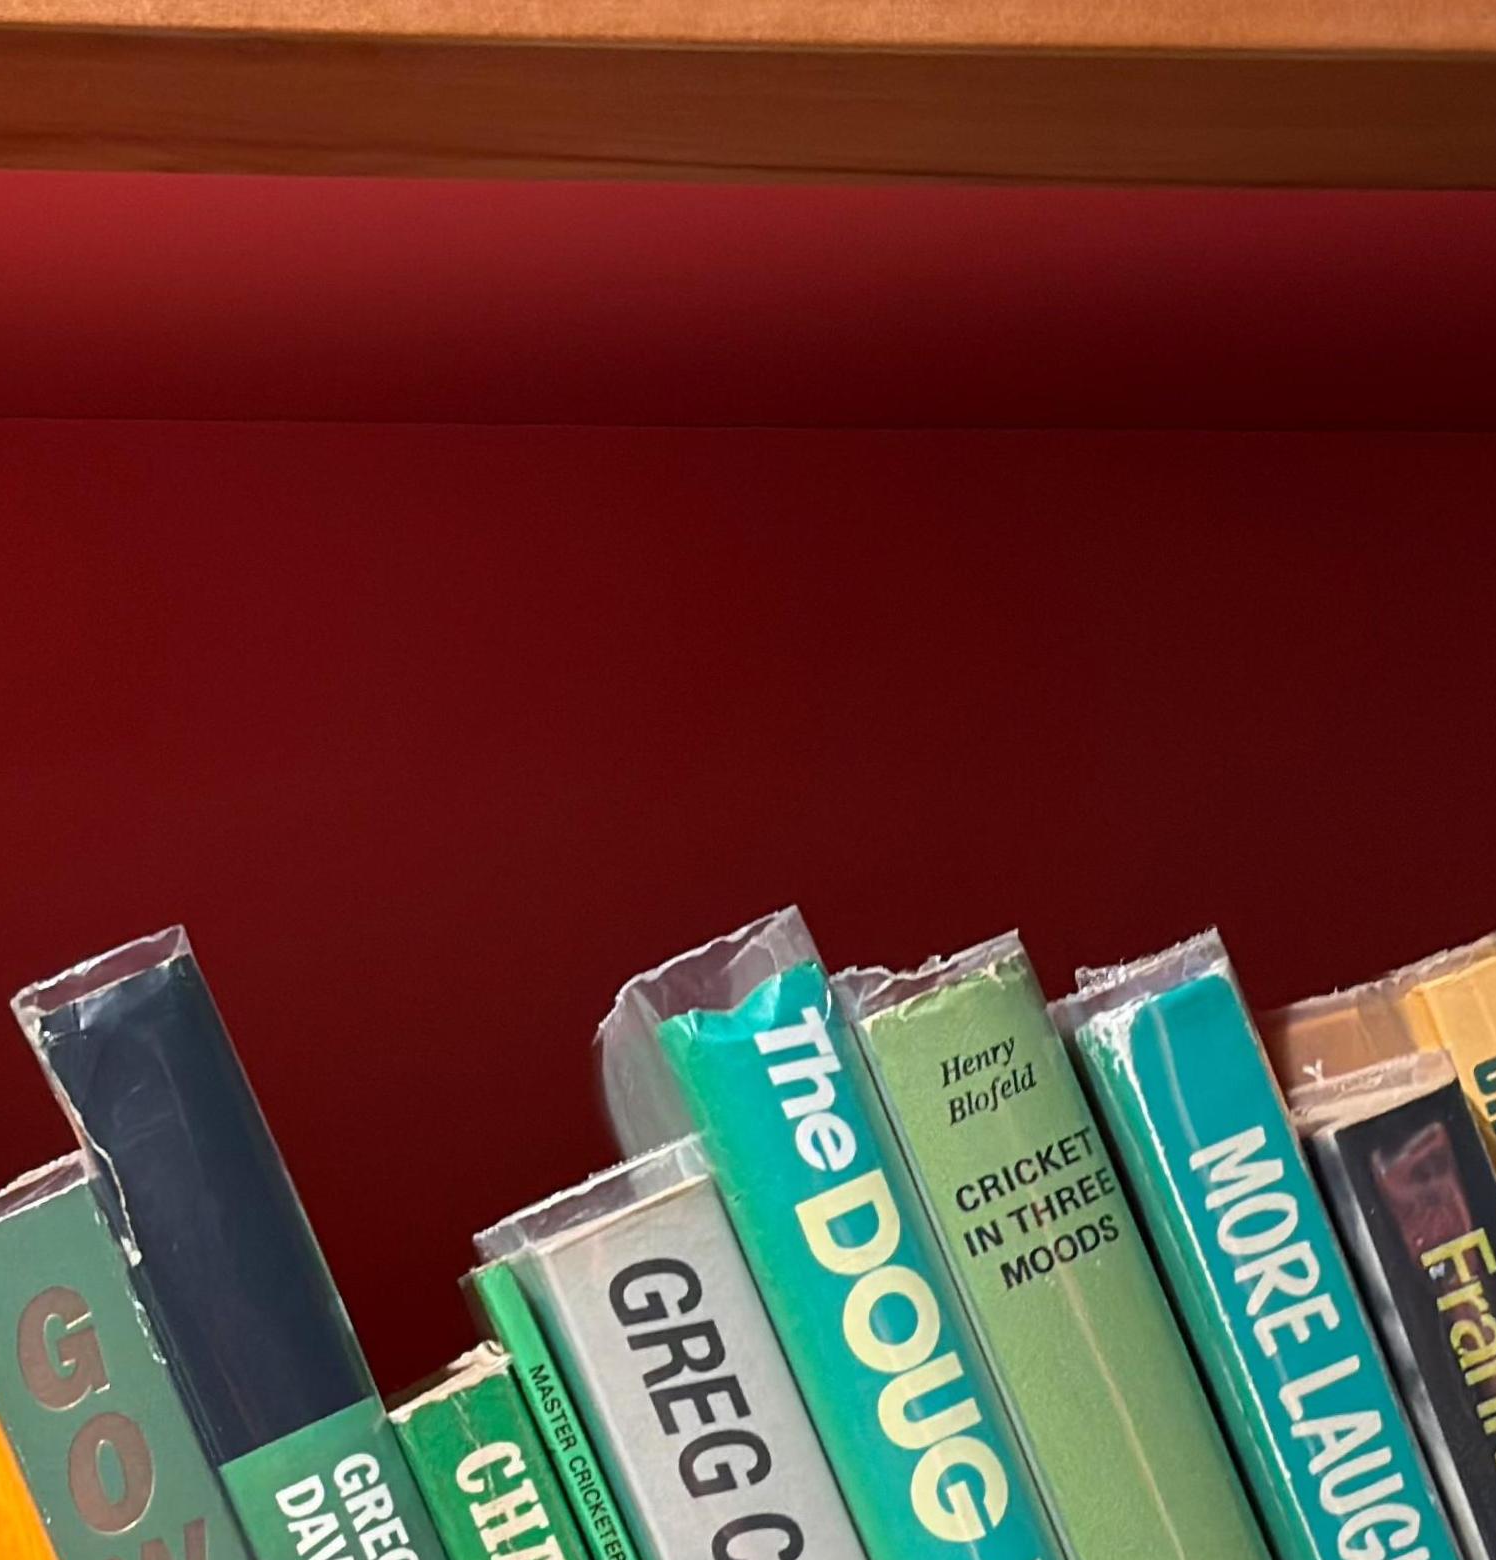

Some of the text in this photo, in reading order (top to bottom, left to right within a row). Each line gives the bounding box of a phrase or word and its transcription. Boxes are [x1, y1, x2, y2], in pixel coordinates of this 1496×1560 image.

[753, 1005, 857, 1173] The
[939, 1036, 1017, 1089] Henry
[948, 1067, 1038, 1127] Blofeld
[955, 1127, 1093, 1214] CRICKET
[964, 1167, 1116, 1259] IN THREE
[1001, 1213, 1120, 1290] MOODS
[1188, 1125, 1340, 1357] MORE
[608, 1257, 771, 1499] GREG
[795, 1168, 1009, 1542] DOUG
[529, 1364, 578, 1455] MASTER
